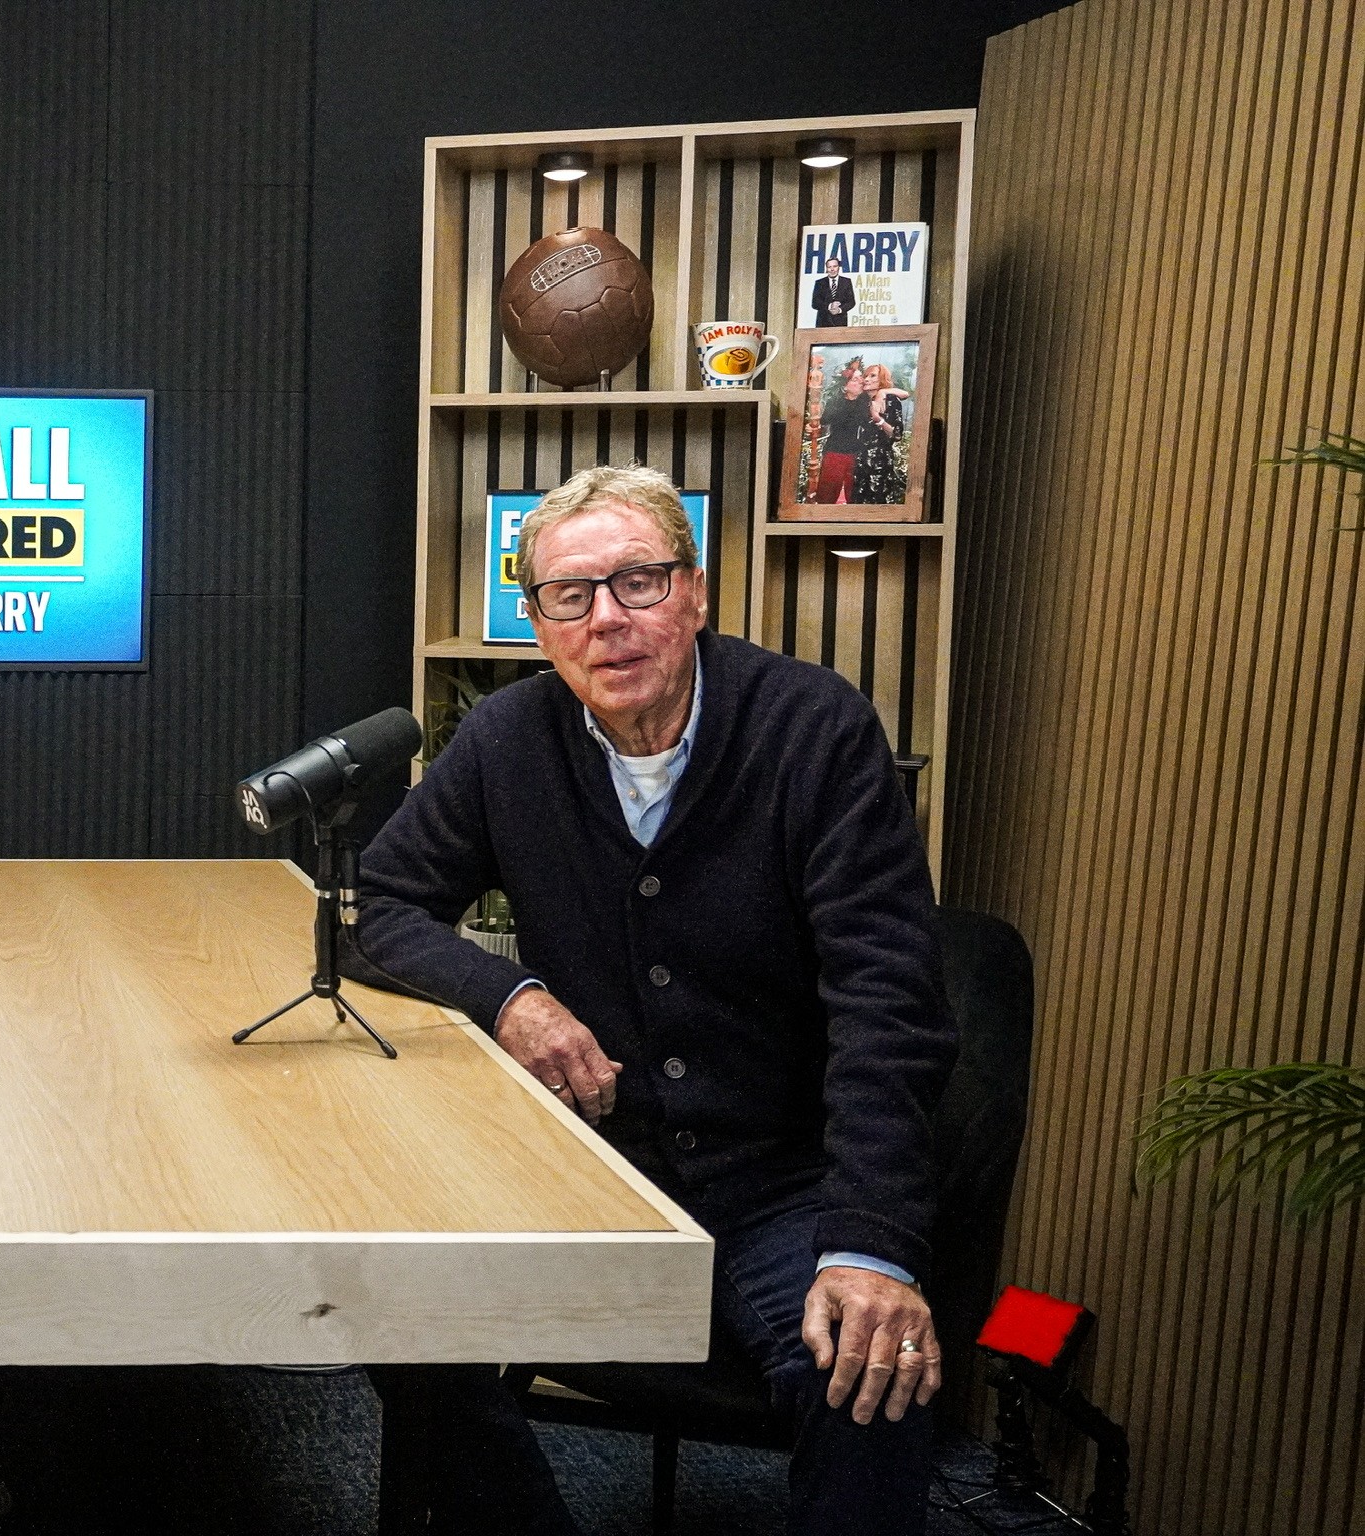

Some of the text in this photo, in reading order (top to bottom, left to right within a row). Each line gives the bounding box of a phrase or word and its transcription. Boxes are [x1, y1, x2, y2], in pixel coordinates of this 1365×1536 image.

[804, 231, 920, 274] HARRY
[855, 274, 891, 288] A Man
[859, 288, 892, 301] Walks
[858, 302, 896, 315] On to a
[702, 328, 723, 344] JAM
[726, 325, 753, 335] ROLY
